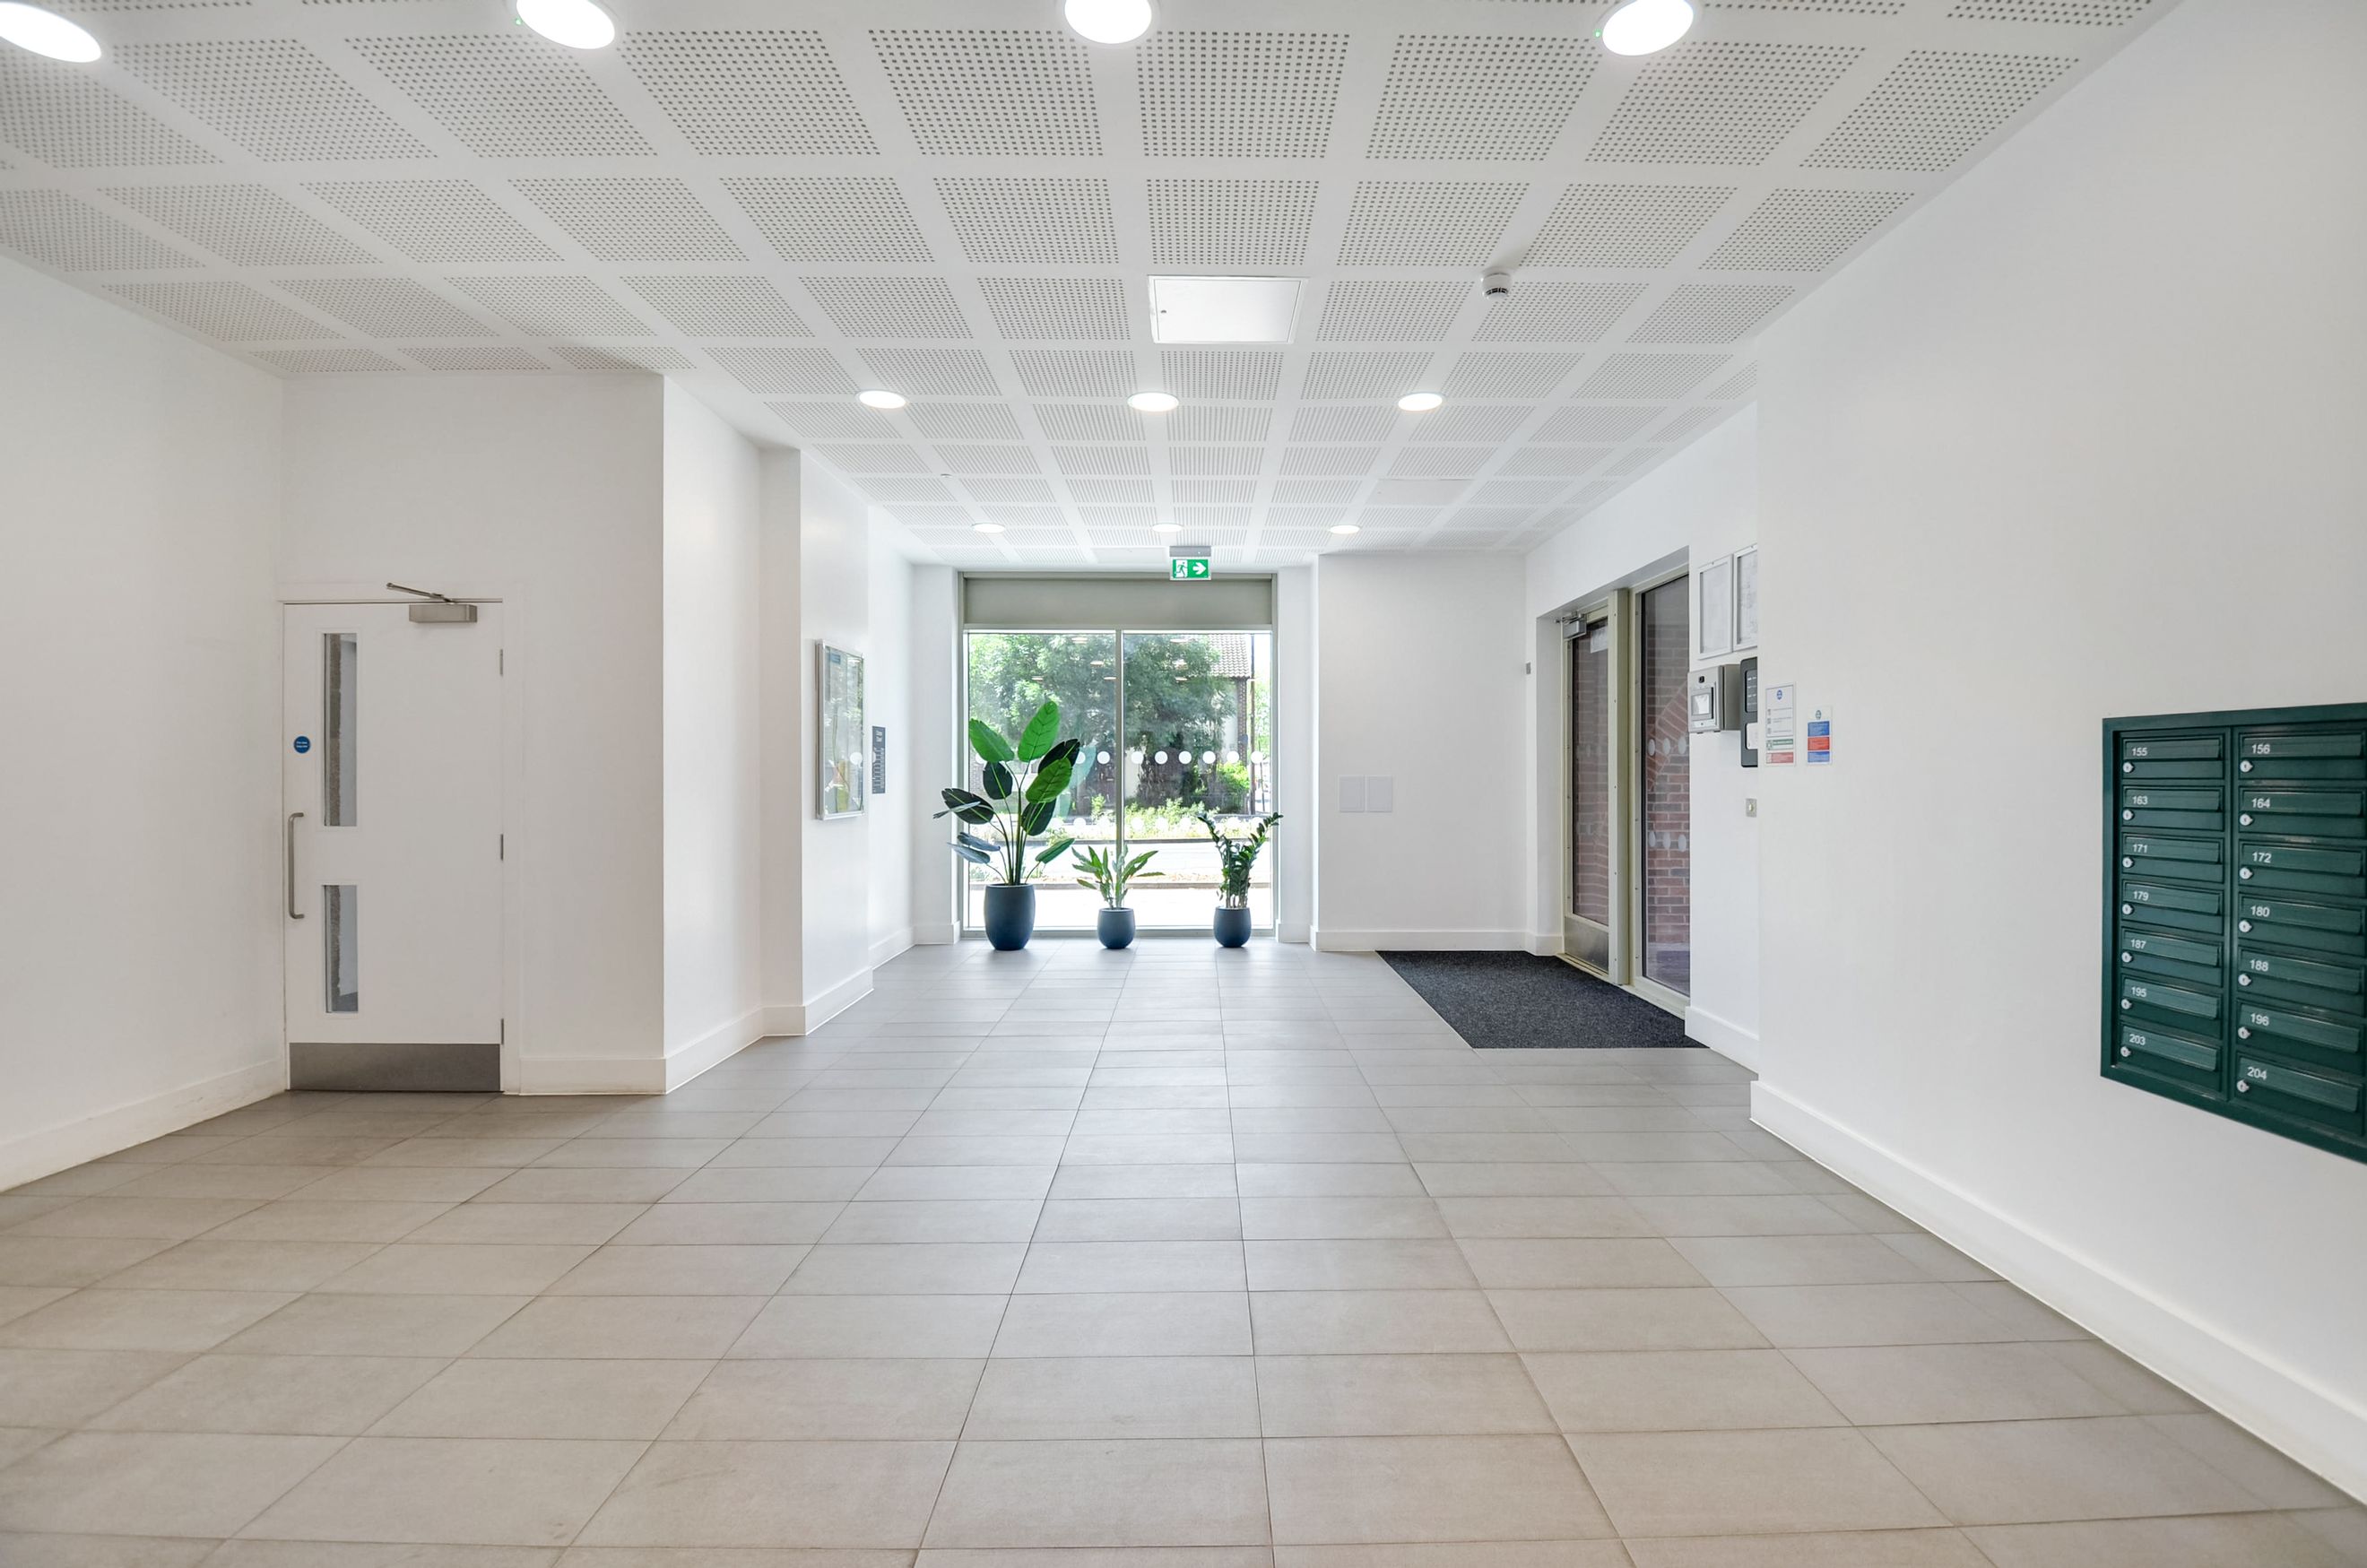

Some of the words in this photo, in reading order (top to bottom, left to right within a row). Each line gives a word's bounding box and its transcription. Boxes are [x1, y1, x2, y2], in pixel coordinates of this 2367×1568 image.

[2132, 747, 2148, 757] 155
[2251, 743, 2271, 755] 156
[2132, 795, 2148, 805] 163
[2251, 798, 2270, 809] 164
[2133, 844, 2148, 853] 171
[2252, 852, 2272, 863] 172
[2133, 890, 2149, 901] 179
[2250, 905, 2270, 917] 180
[2130, 939, 2146, 949] 187
[2250, 959, 2269, 972] 188
[2131, 986, 2147, 998] 195
[2250, 1013, 2269, 1027] 196
[2129, 1033, 2146, 1046] 203
[2247, 1066, 2267, 1080] 204
